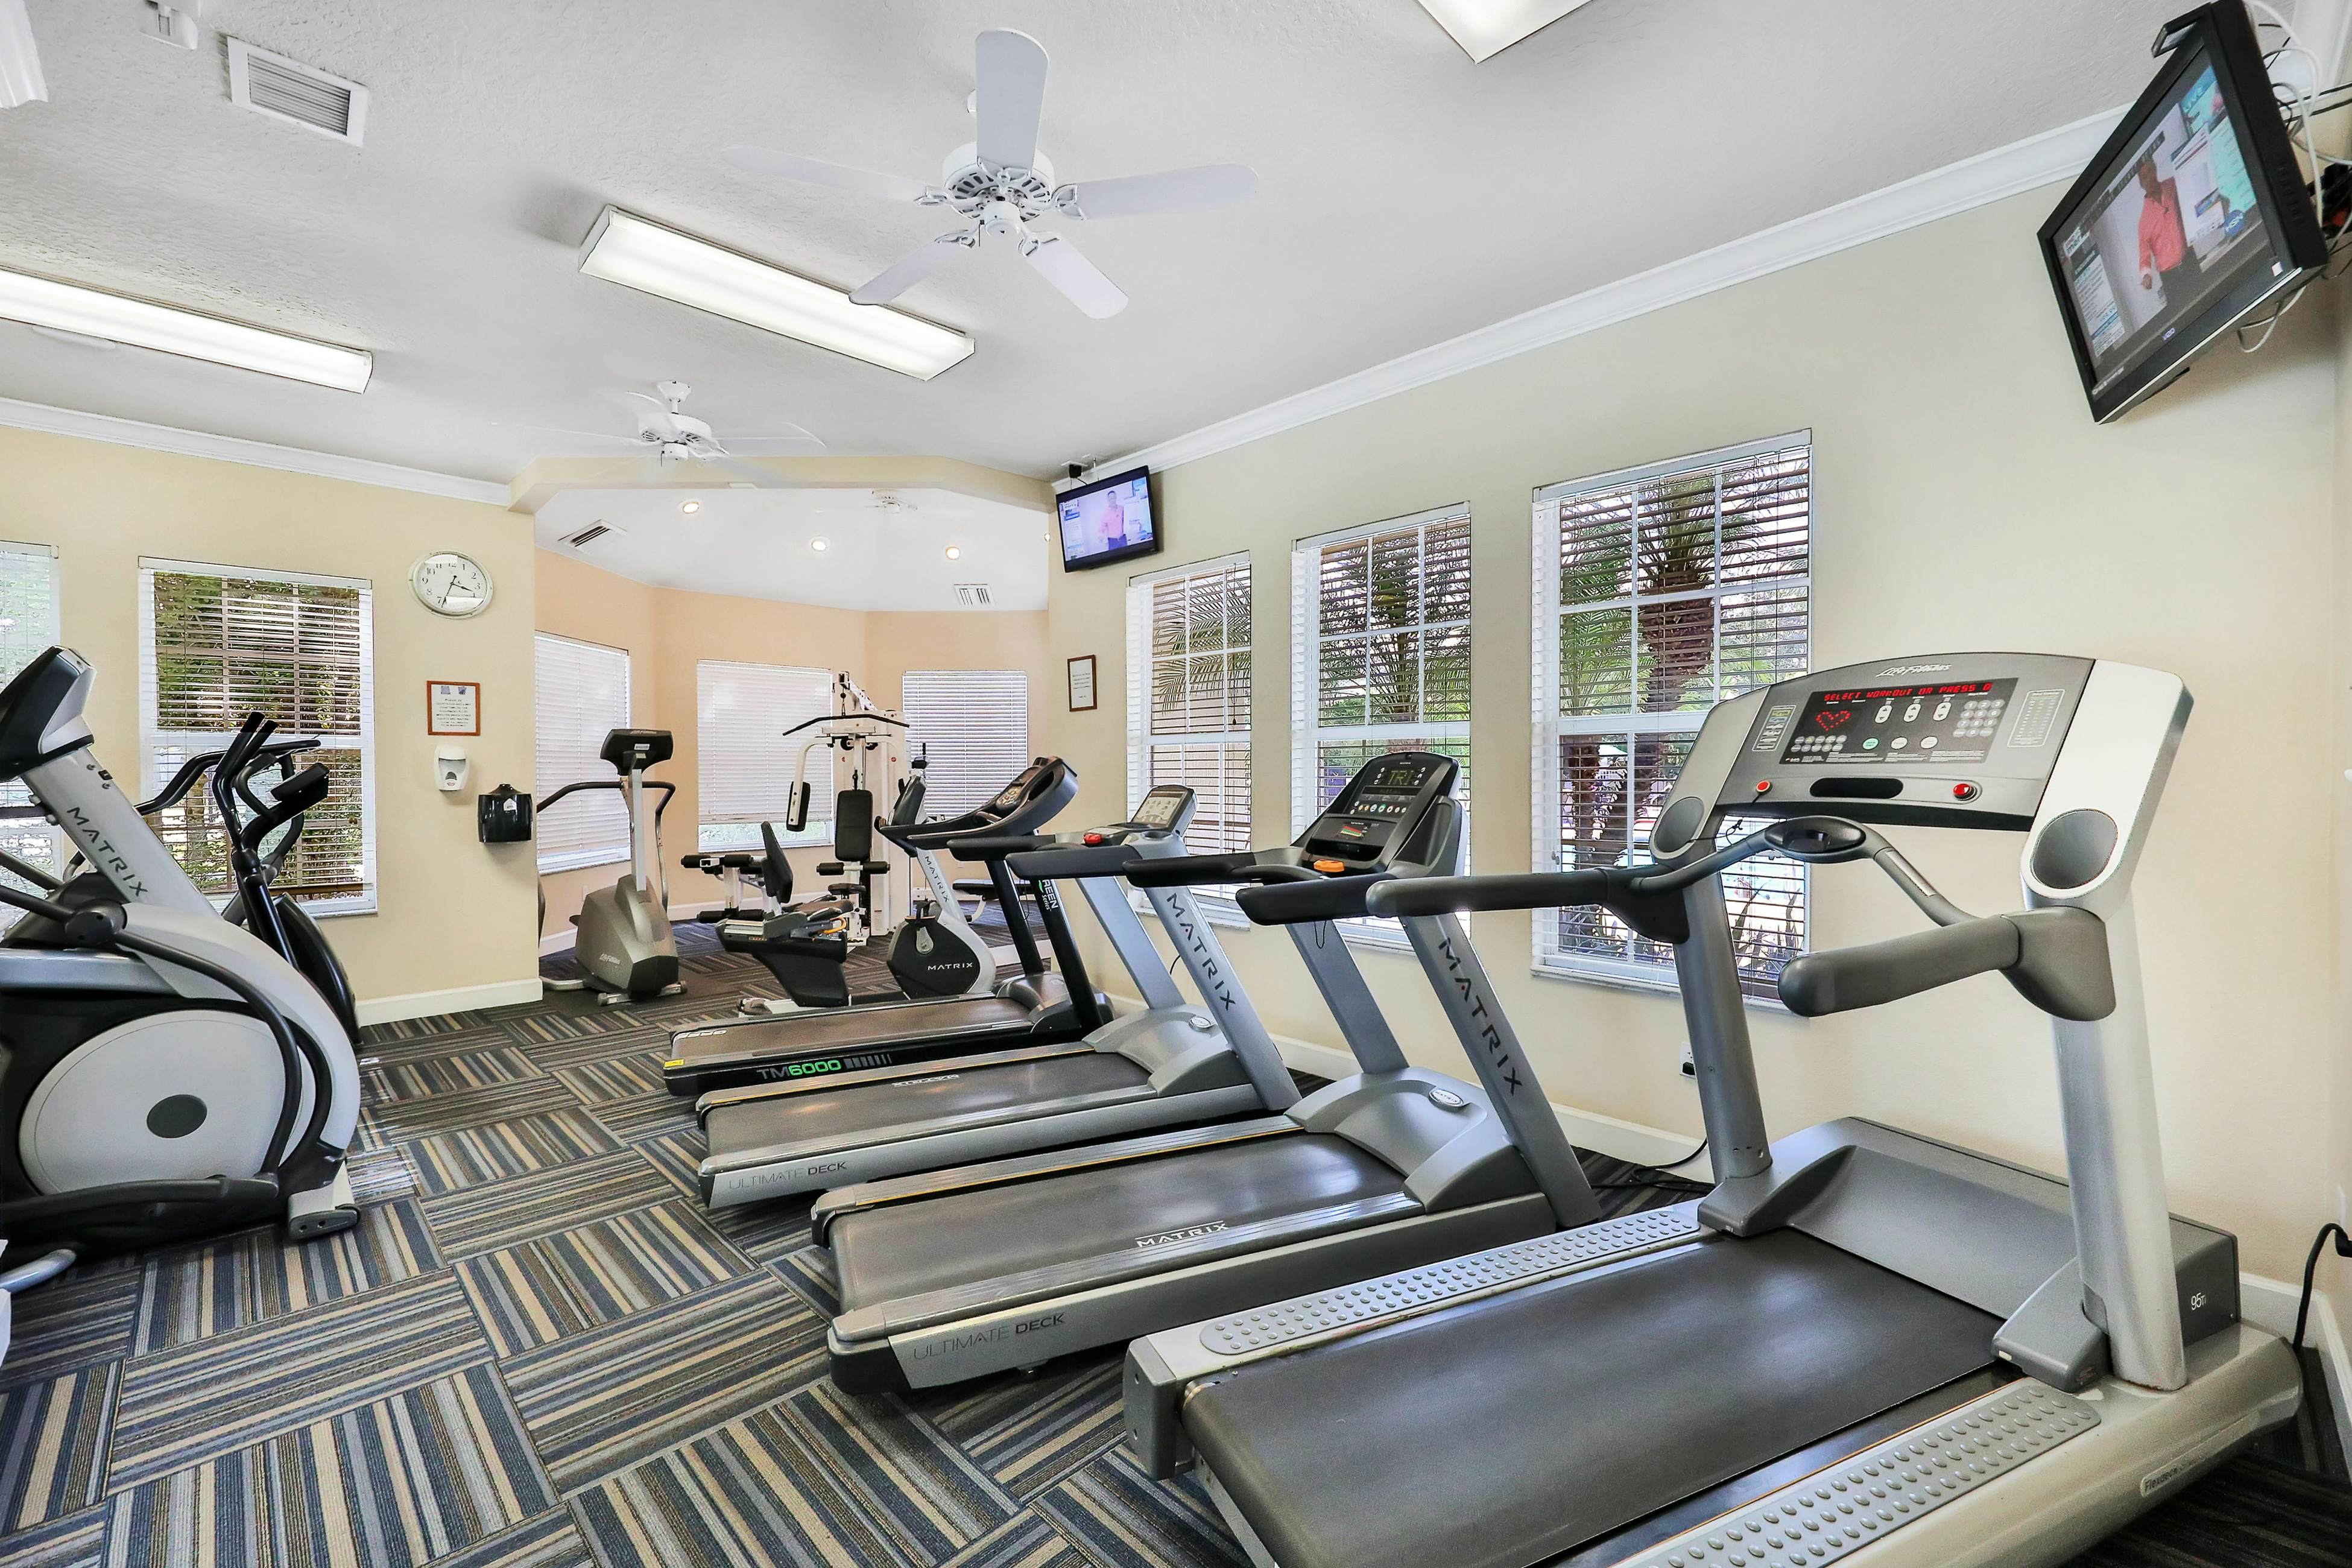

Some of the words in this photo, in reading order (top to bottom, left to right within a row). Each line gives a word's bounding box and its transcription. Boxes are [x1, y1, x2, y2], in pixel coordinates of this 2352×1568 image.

[1824, 692, 1861, 701] SELECT
[1918, 687, 1933, 695] OR
[1938, 684, 1976, 694] PRESS
[67, 807, 148, 897] MATRIX
[925, 856, 949, 902] MATRIX
[928, 962, 973, 971] MATRIX
[1166, 893, 1236, 1011] MATRIX
[1439, 937, 1523, 1096] MATRIX
[756, 1060, 842, 1080] TM6000
[729, 1168, 803, 1190] ULTIMATE
[808, 1162, 847, 1175] DECK
[1136, 1223, 1229, 1248] MATRIX
[913, 1326, 1010, 1359] ULTIMATE
[1015, 1312, 1066, 1334] DECK
